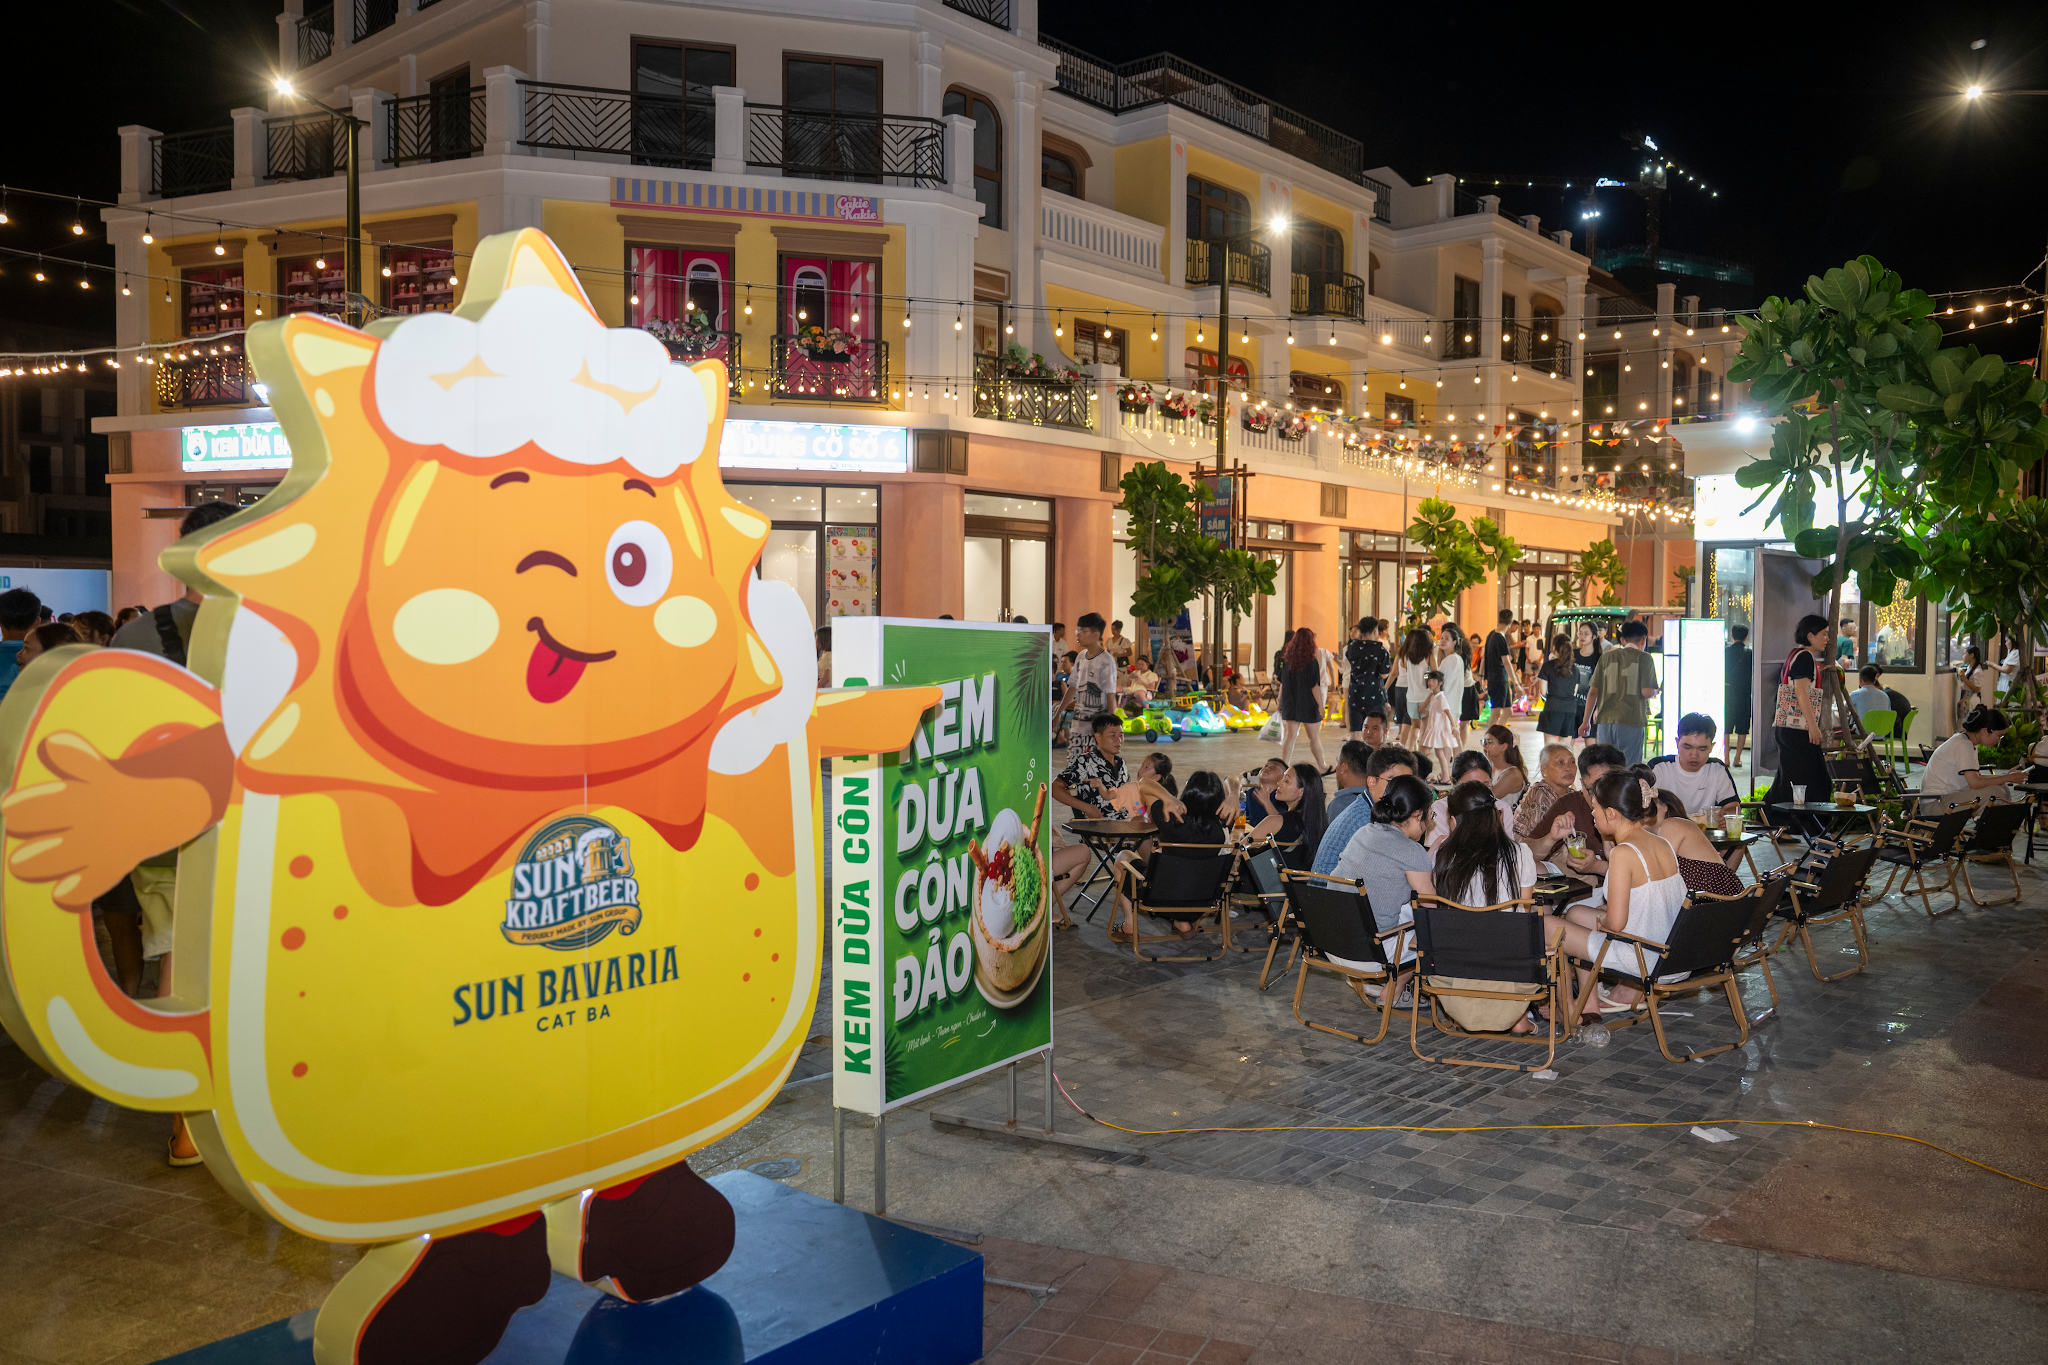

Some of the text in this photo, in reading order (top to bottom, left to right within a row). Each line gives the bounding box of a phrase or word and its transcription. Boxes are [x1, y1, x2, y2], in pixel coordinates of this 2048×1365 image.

[837, 196, 870, 209] Cakie
[840, 208, 877, 220] Kakie
[211, 437, 239, 458] KEM
[883, 438, 899, 459] 6
[1604, 662, 1639, 695] 11
[837, 777, 870, 864] CÔN
[896, 761, 984, 854] DỪA
[513, 851, 577, 900] SUN
[894, 849, 969, 931] CÔN
[505, 877, 640, 929] KRAFTBEER
[521, 908, 628, 941] PROUDLY MADE BY SUN GROUP
[837, 880, 871, 965] DỪA
[453, 945, 680, 1027] SUN BAVARIA
[893, 927, 972, 1022] ĐẢO
[536, 1003, 611, 1032] CAT BA
[844, 979, 872, 1075] KEM
